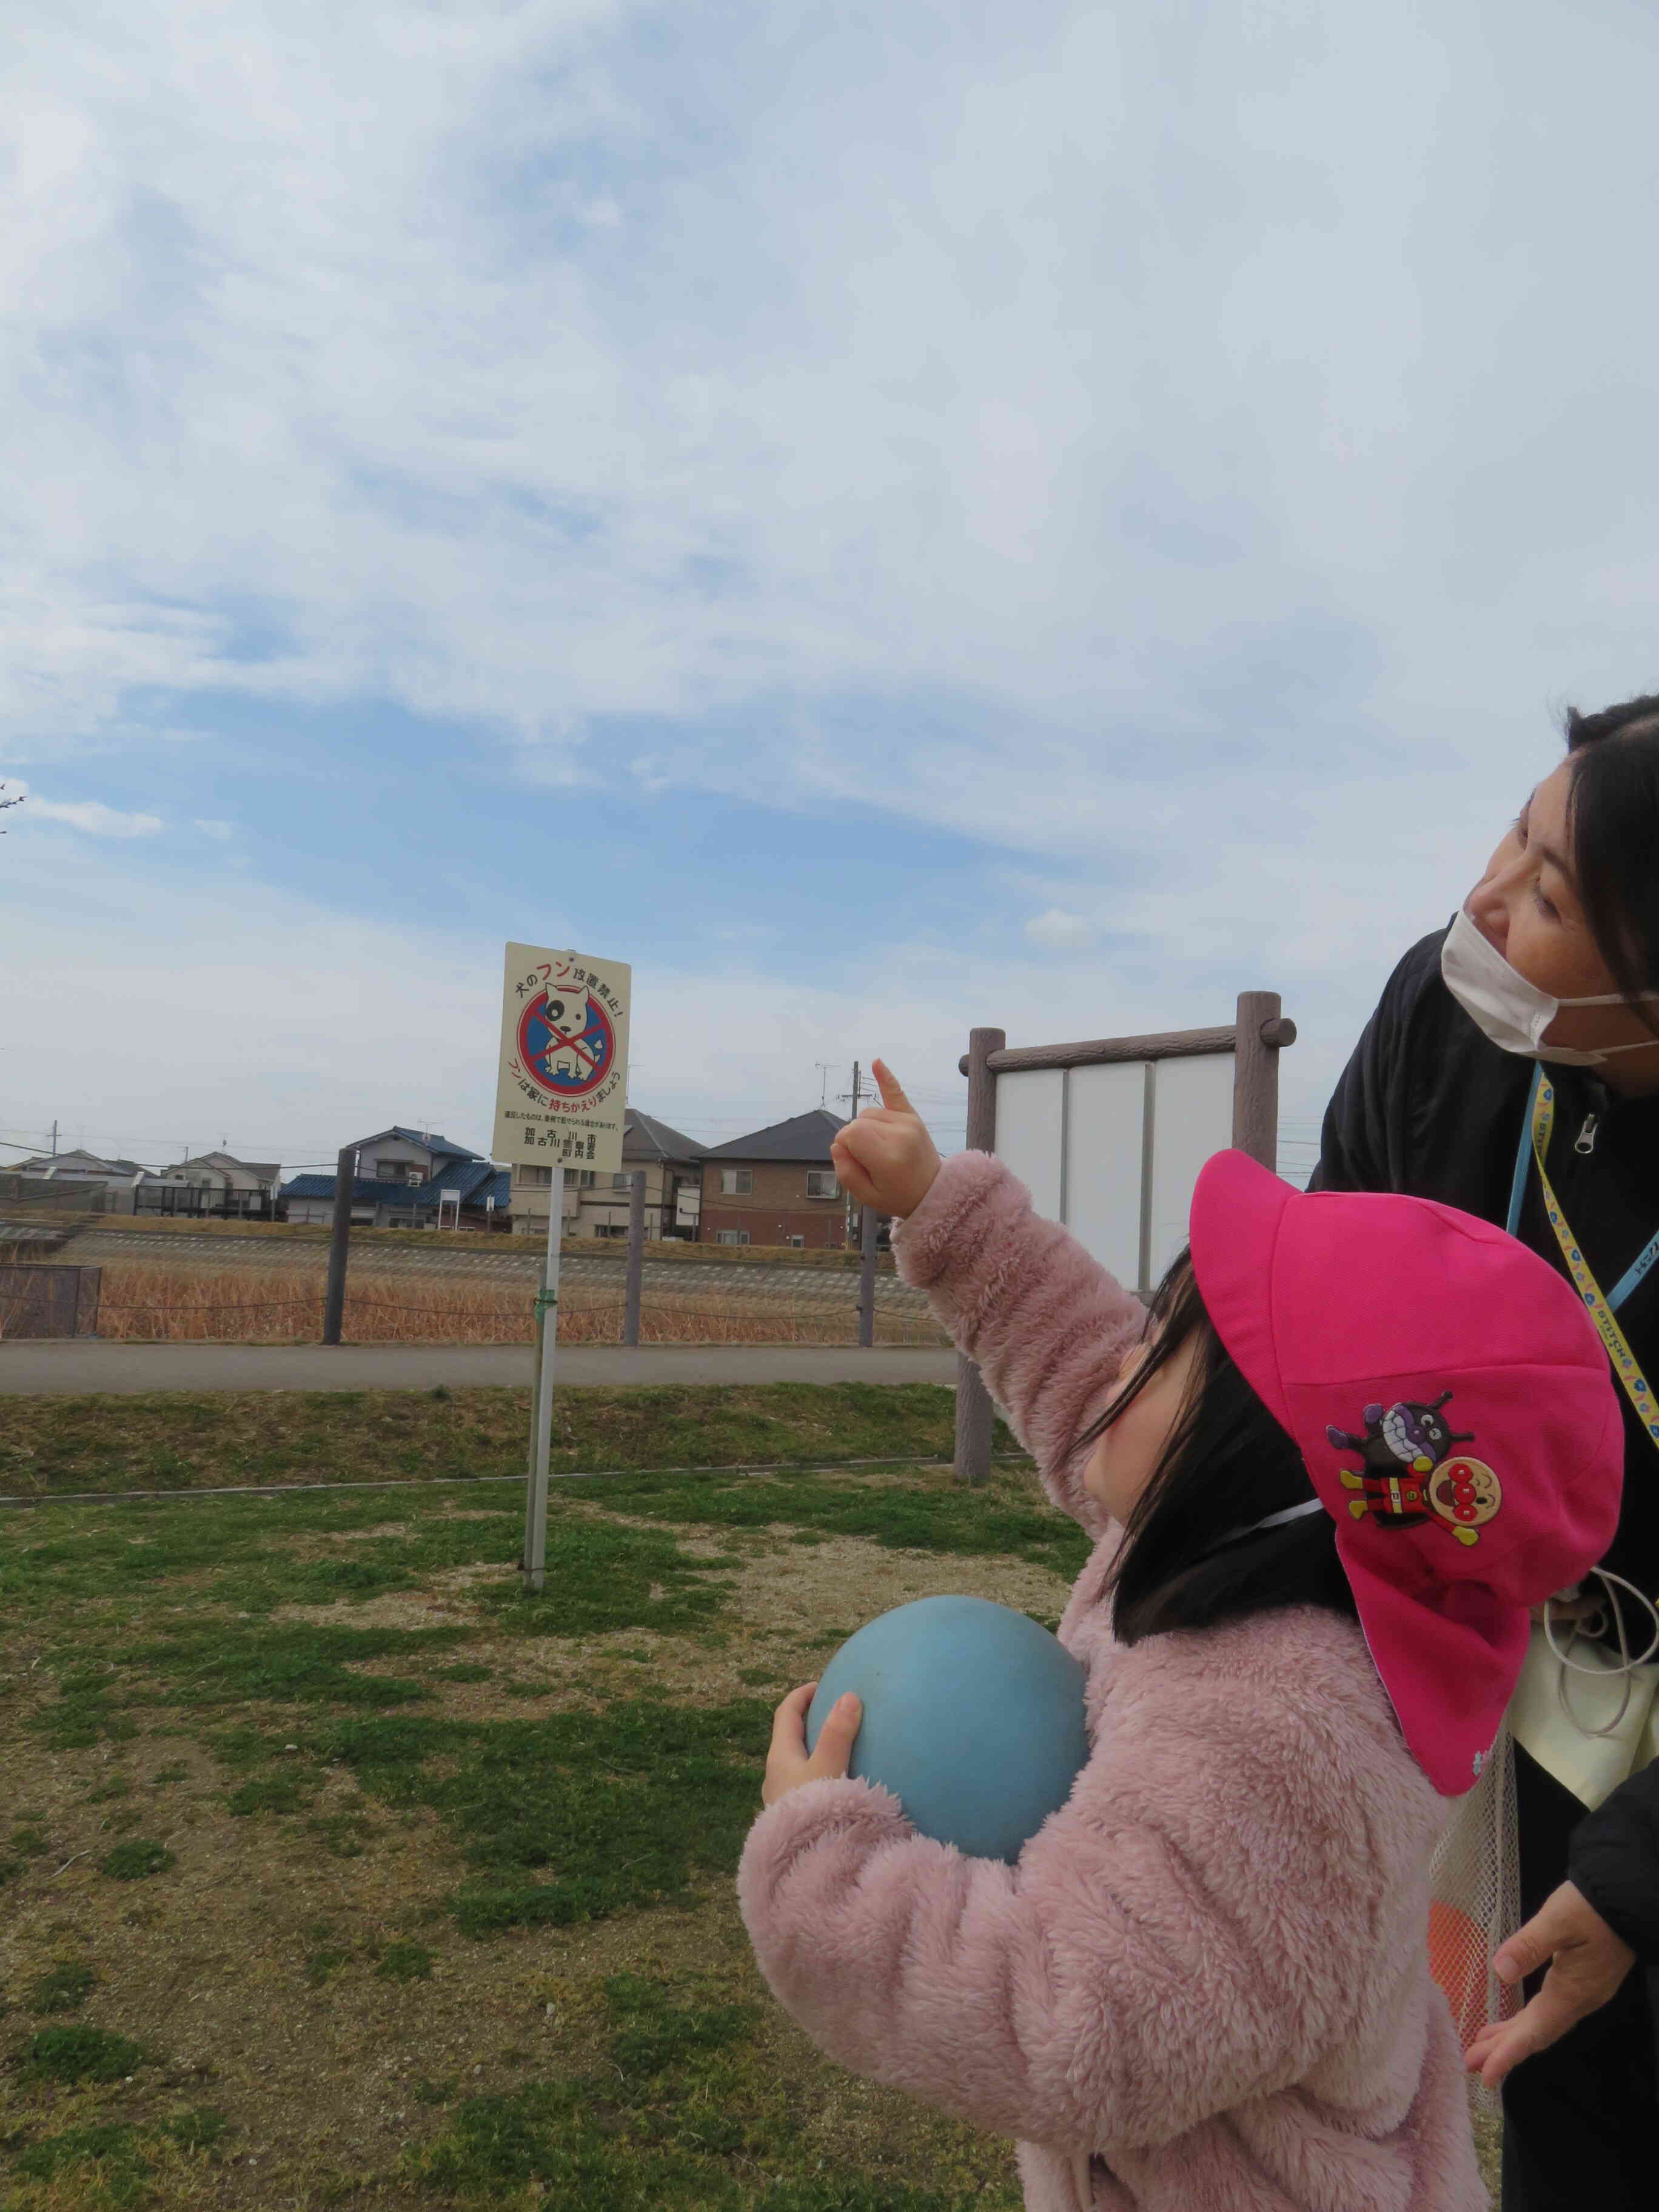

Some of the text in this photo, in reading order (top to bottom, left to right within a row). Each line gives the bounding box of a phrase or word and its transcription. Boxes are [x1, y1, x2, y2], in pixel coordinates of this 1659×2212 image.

[562, 1148, 595, 1159] 町内会
[1598, 1310, 1626, 1357] STITCH
